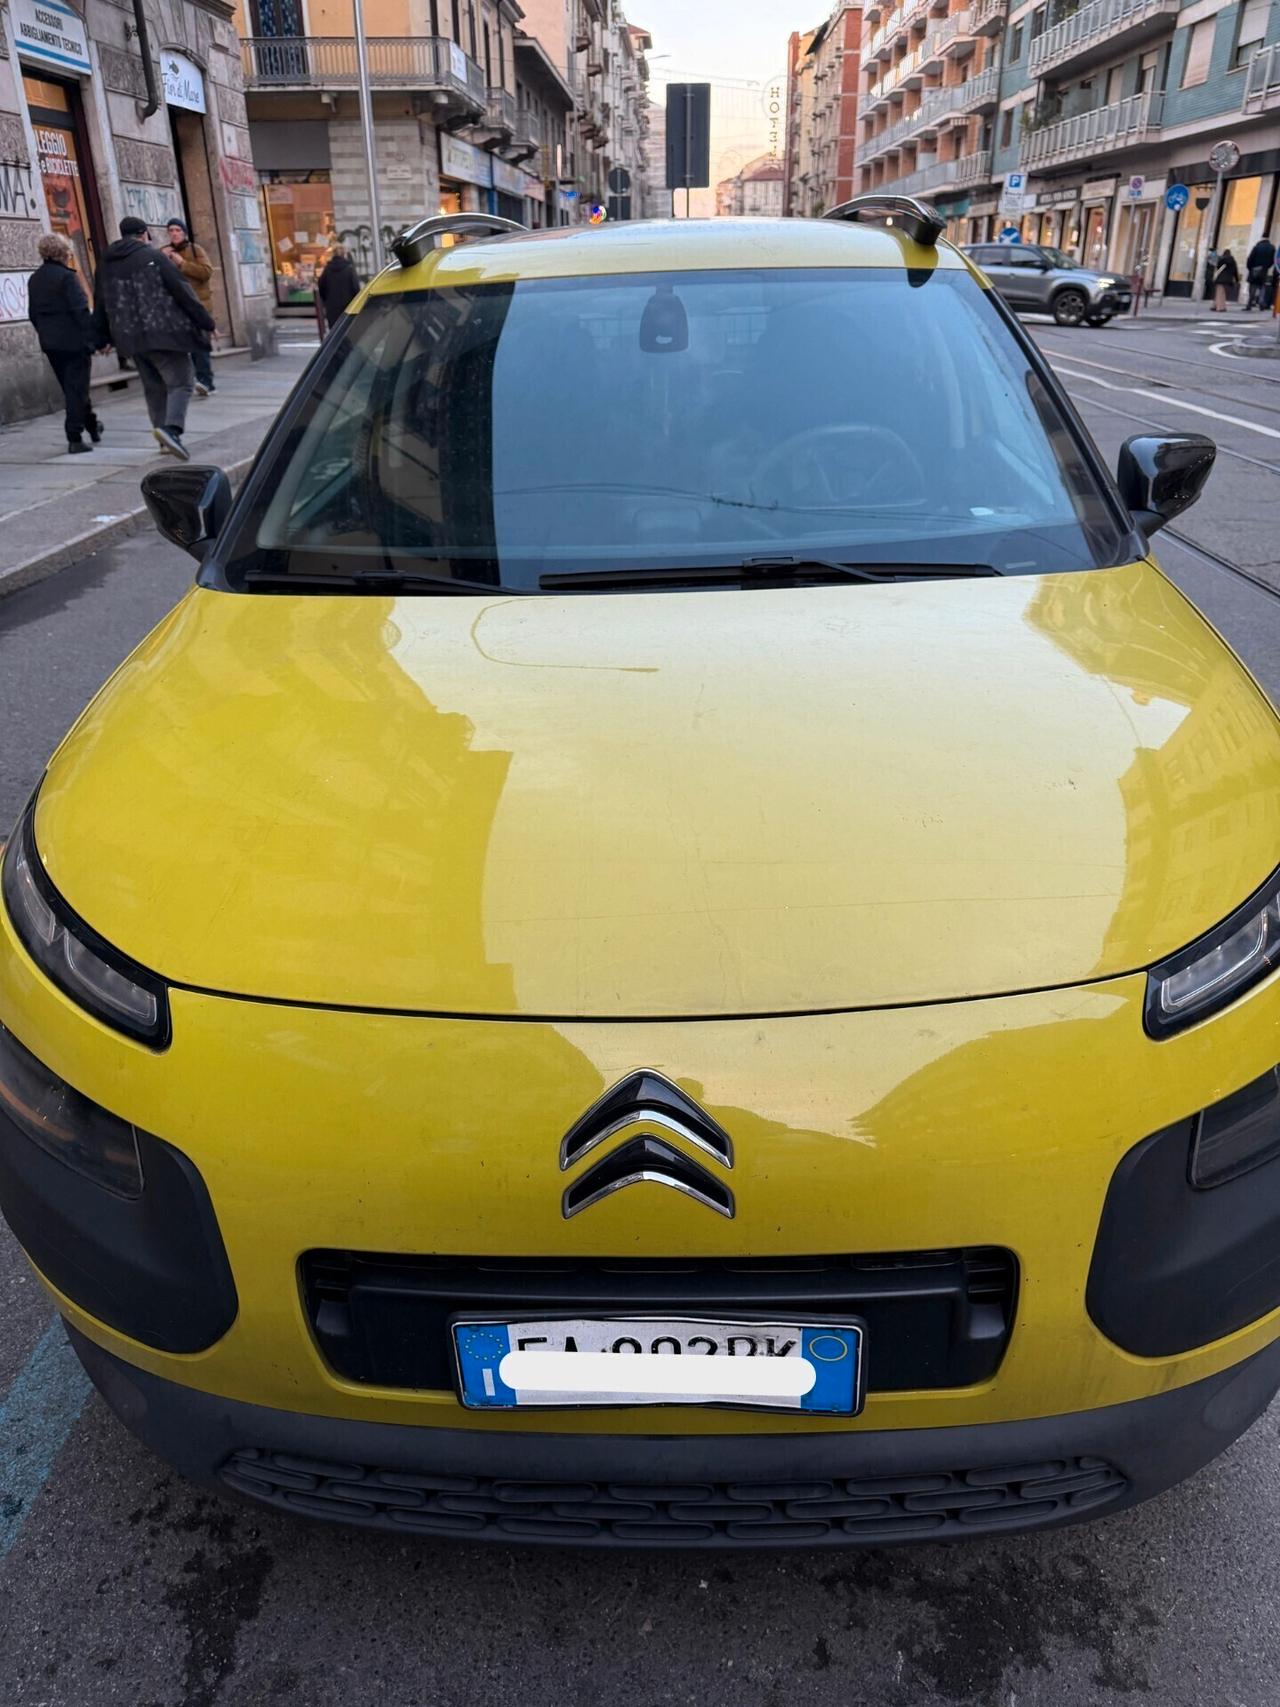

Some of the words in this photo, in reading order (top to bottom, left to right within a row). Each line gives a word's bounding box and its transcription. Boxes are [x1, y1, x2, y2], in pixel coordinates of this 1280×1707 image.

[20, 22, 62, 49] ABBIGLIAMENTO
[61, 37, 83, 56] TECNICO
[482, 1368, 496, 1396] I
